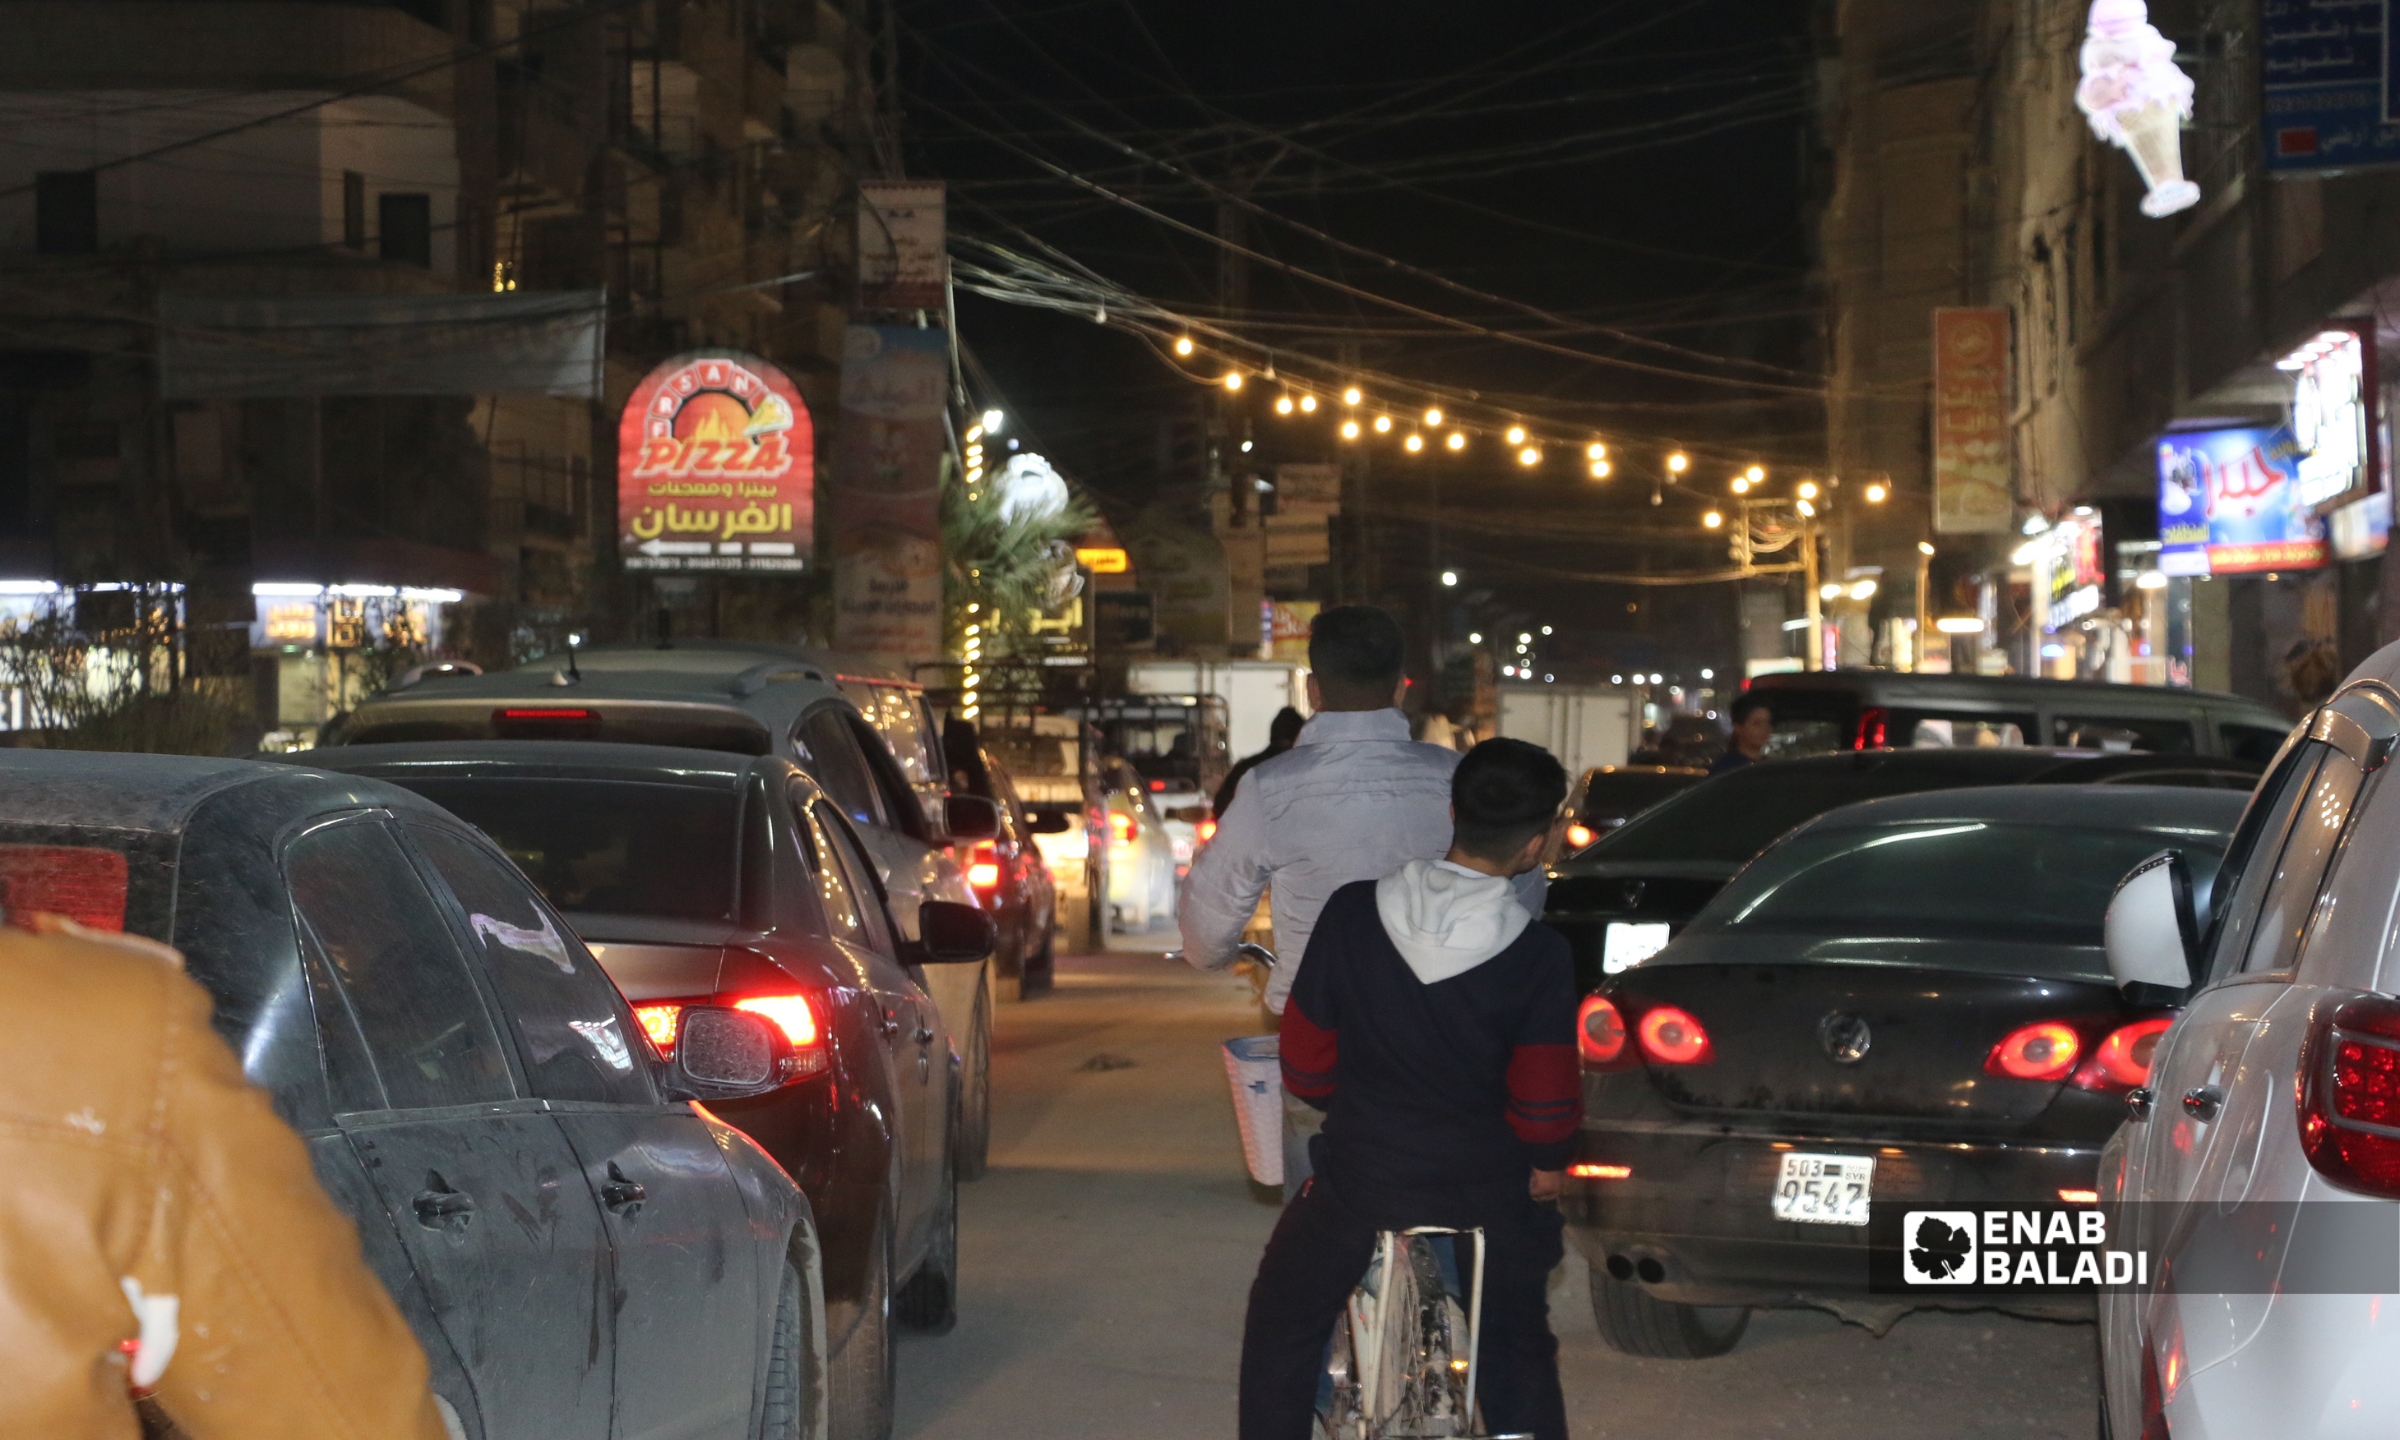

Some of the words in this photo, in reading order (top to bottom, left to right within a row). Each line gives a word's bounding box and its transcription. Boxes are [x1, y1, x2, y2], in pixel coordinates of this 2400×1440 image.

[636, 436, 793, 477] PIZZA
[647, 480, 733, 499] ومعجنات
[631, 501, 794, 541] الفرسان
[1787, 1158, 1822, 1177] 503
[1845, 1172, 1867, 1181] SYR
